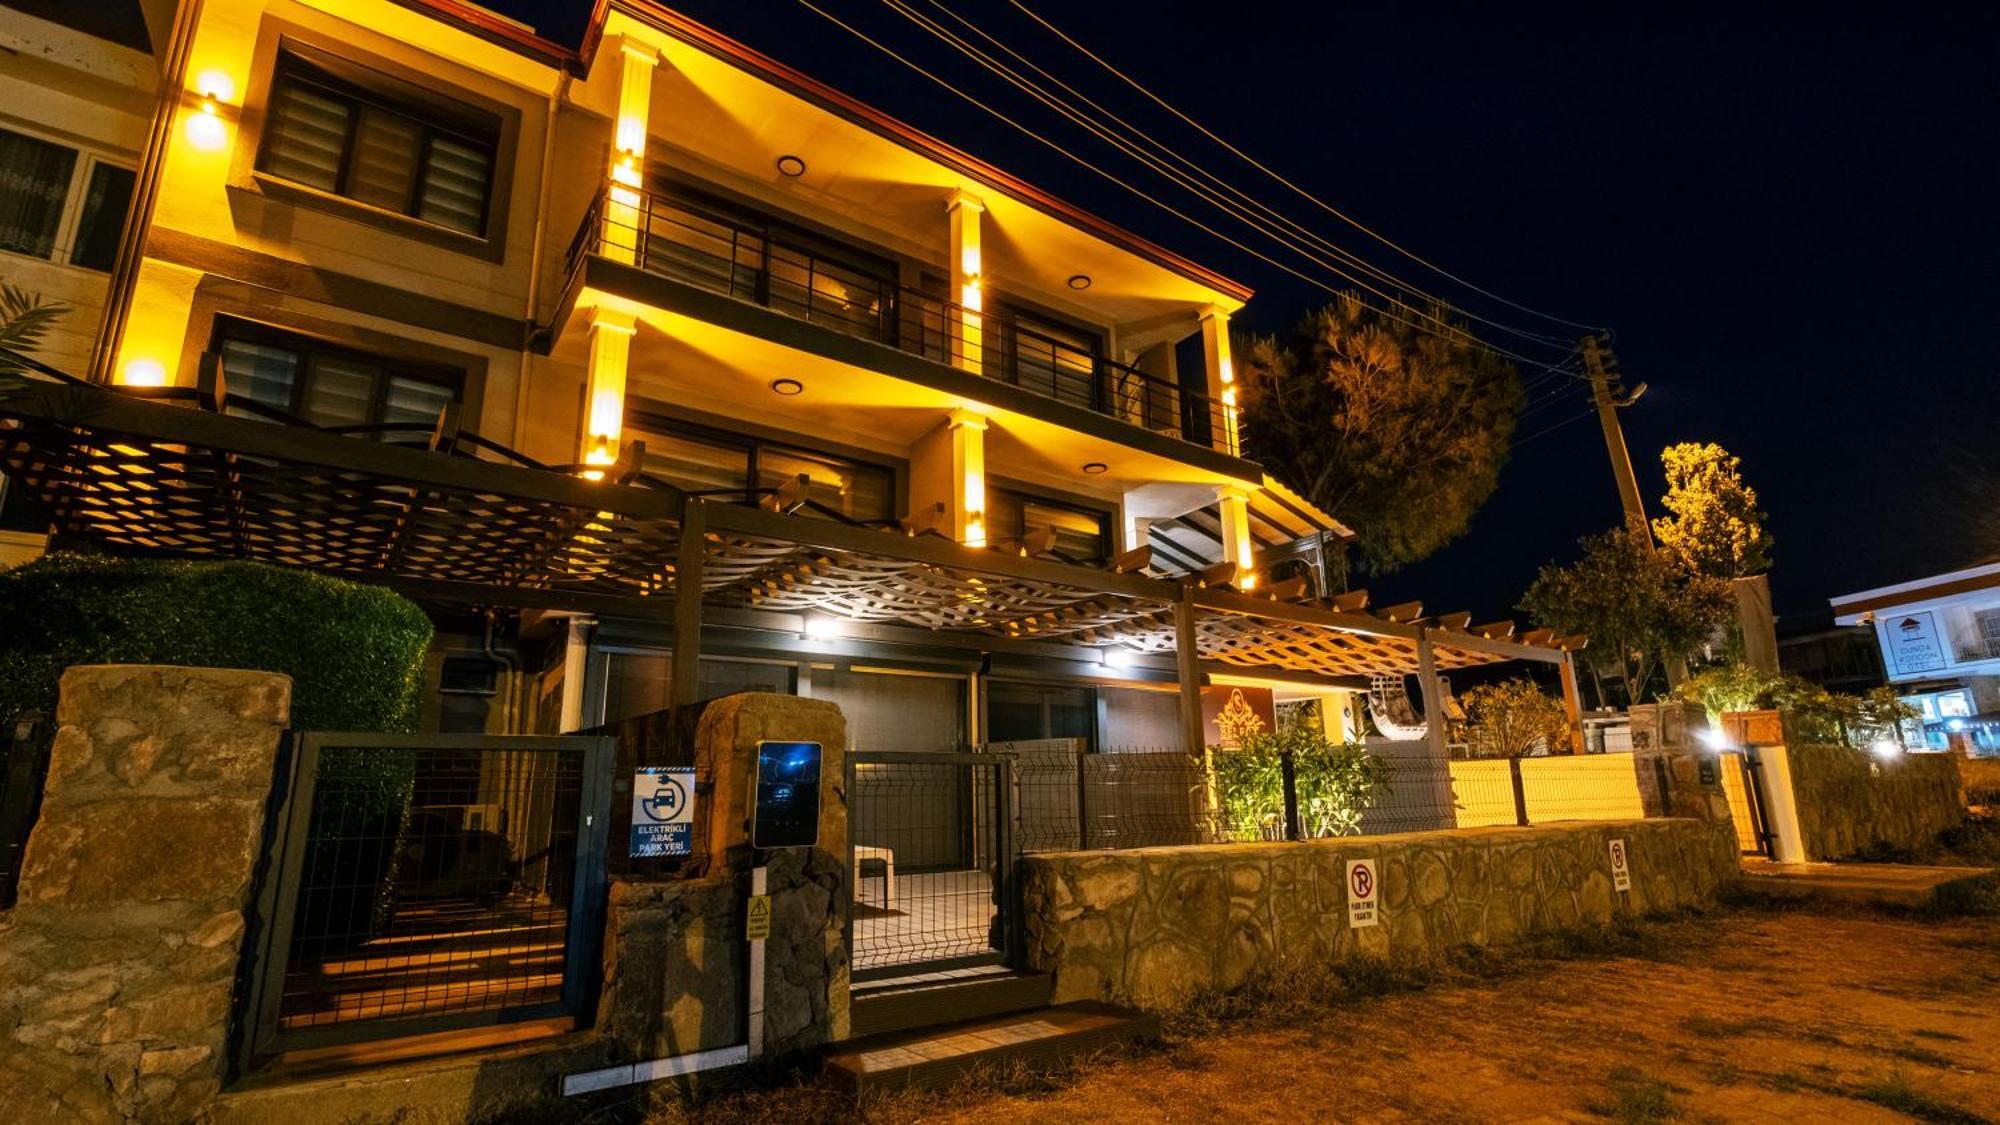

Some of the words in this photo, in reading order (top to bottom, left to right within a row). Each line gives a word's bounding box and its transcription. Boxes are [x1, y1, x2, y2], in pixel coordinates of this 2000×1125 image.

[638, 823, 687, 834] ELEKTRİKLİ
[650, 832, 674, 843] ARAÇ
[639, 842, 663, 852] PARK
[664, 840, 684, 851] YERİ
